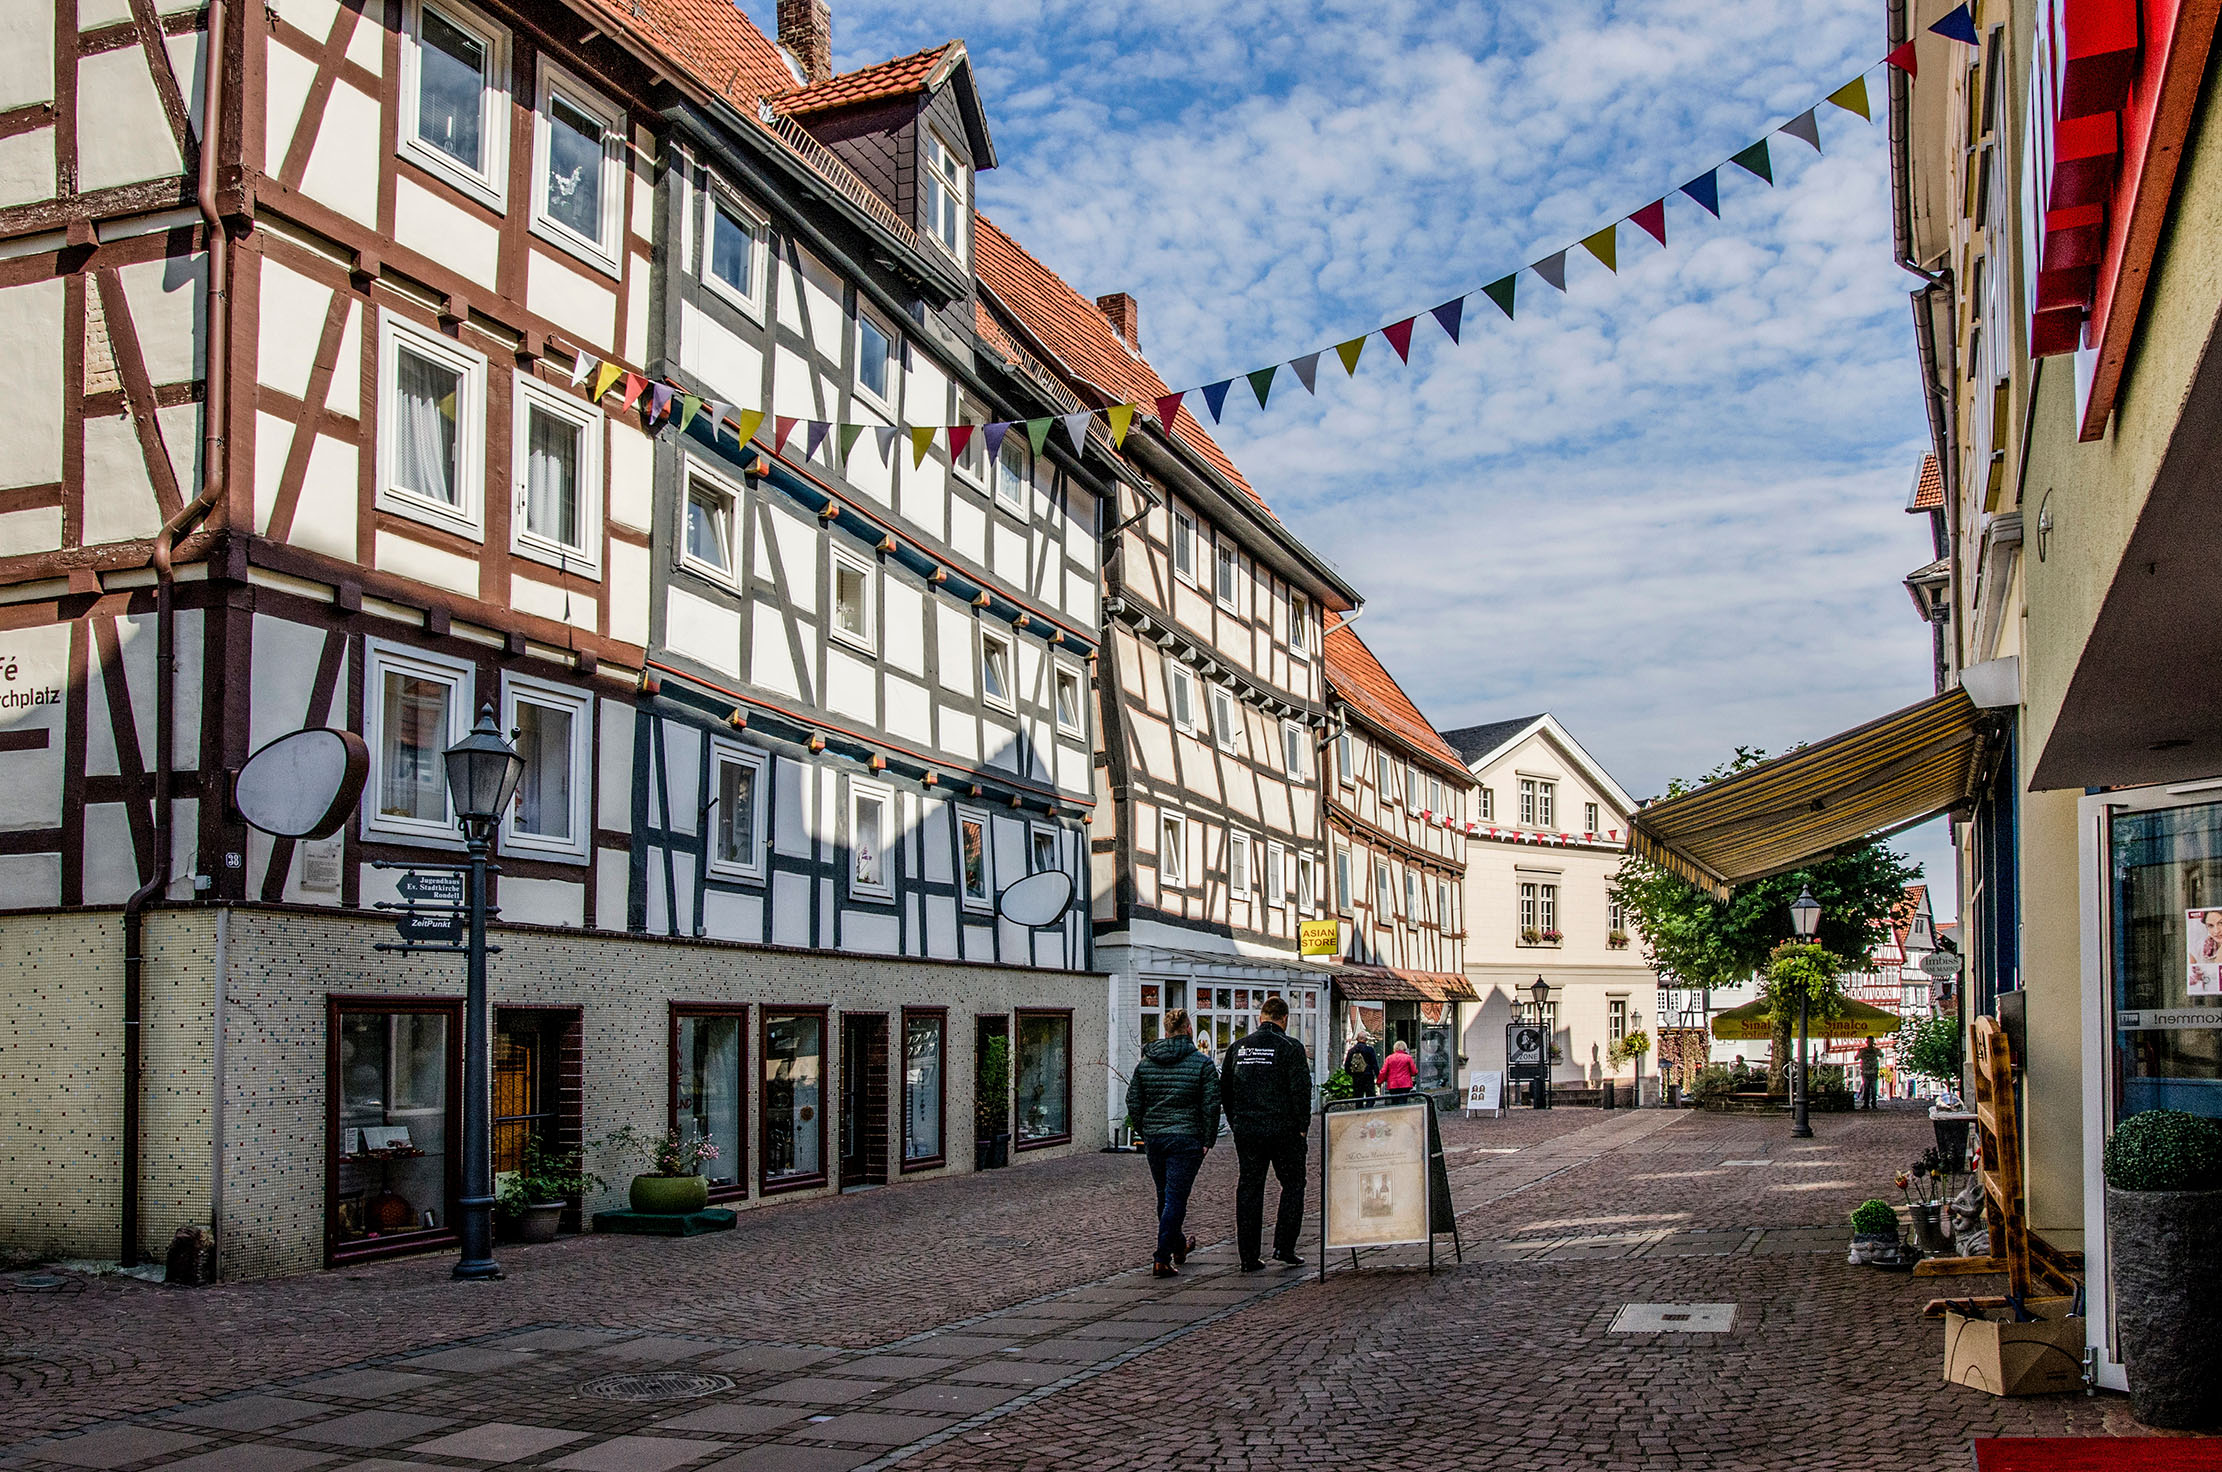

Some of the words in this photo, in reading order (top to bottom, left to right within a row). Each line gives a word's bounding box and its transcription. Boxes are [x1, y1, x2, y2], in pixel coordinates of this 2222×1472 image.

[0, 687, 61, 709] chplatz
[227, 854, 239, 866] 38
[420, 877, 460, 885] Jugendhaus
[420, 884, 460, 892] Stadtkirche
[412, 919, 451, 928] ZeitPunkt
[1302, 928, 1335, 938] ASIAN
[1301, 938, 1337, 947] STORE
[1925, 956, 1959, 966] Imbiss
[1824, 1018, 1868, 1030] Sinalco
